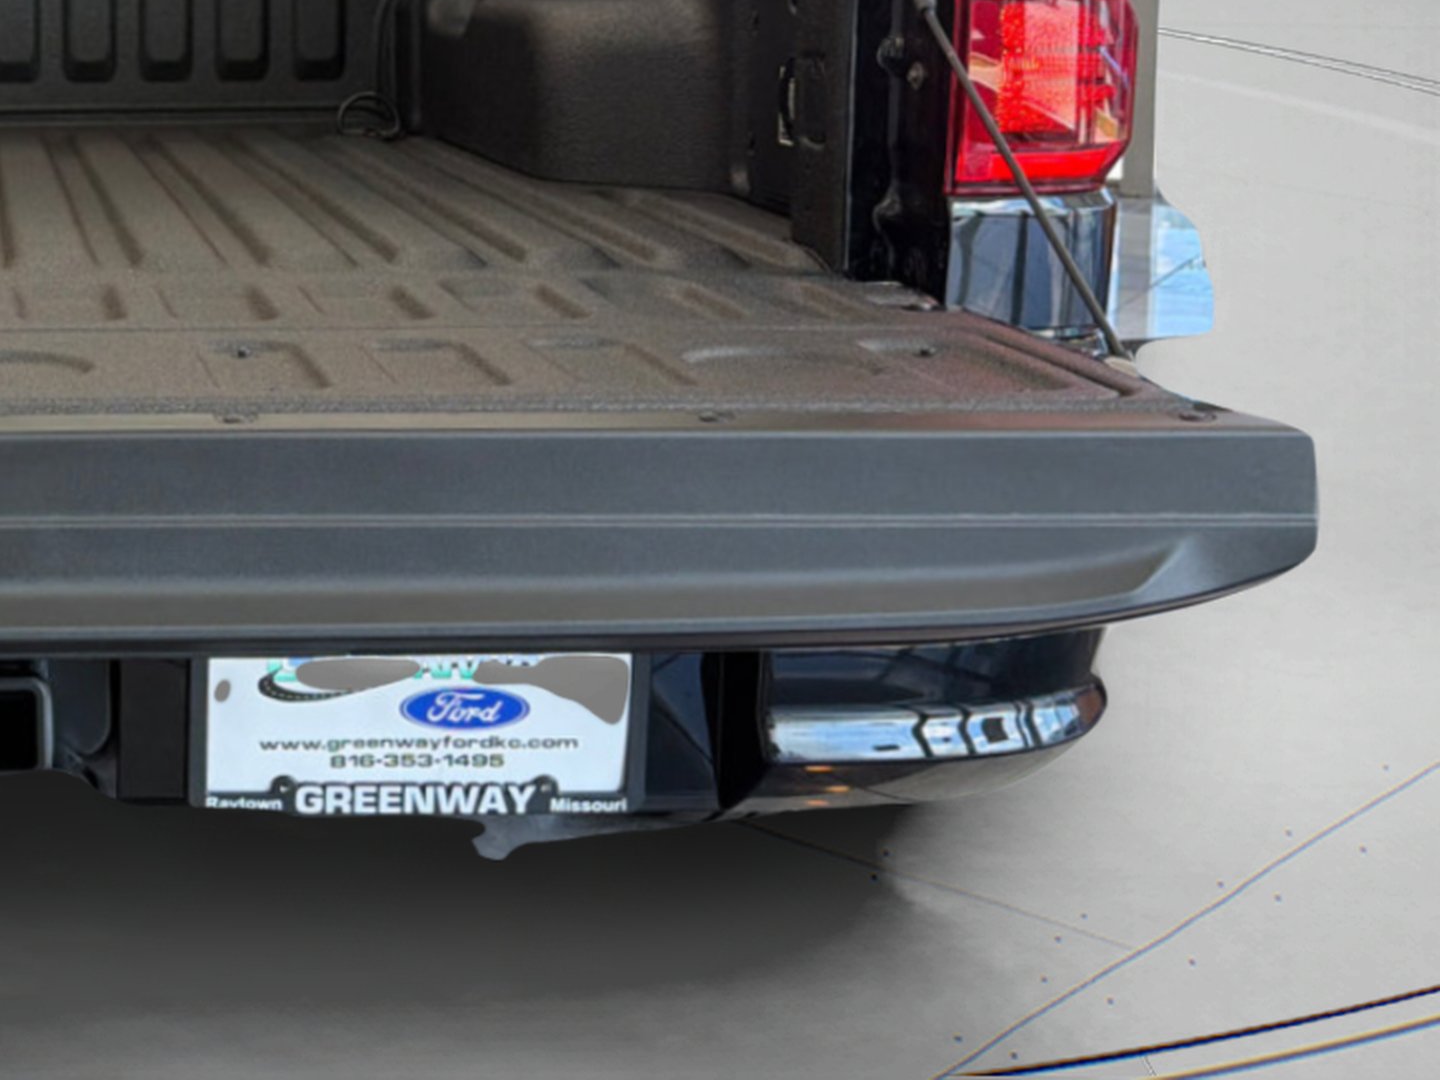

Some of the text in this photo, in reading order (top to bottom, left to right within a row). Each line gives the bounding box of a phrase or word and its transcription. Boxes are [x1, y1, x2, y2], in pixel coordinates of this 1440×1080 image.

[426, 691, 504, 723] Ford
[260, 735, 579, 752] www.greenwayfordkc.com
[330, 754, 505, 768] 816-353-1495
[295, 785, 536, 815] GREENWAY
[550, 798, 627, 812] Missouri
